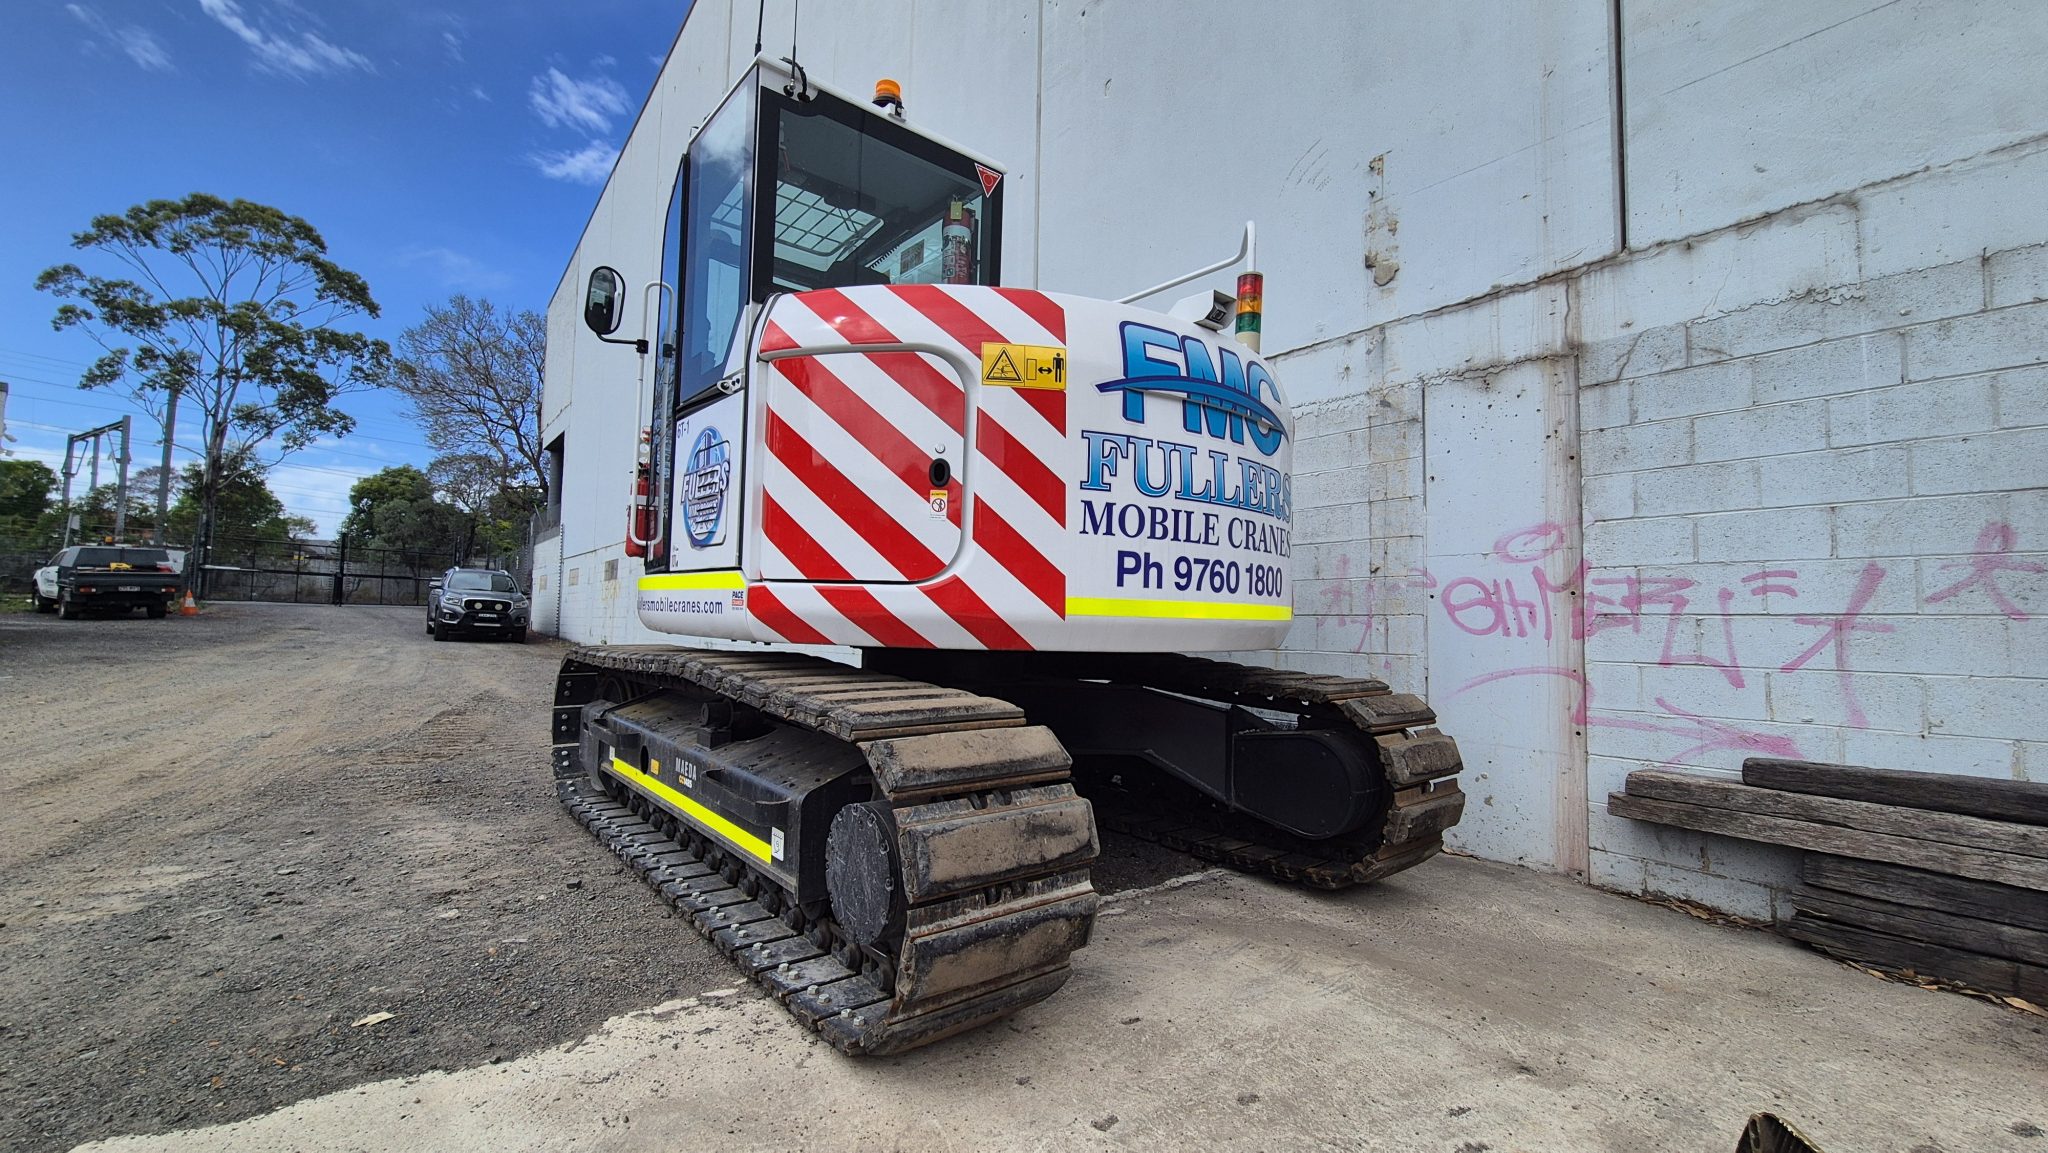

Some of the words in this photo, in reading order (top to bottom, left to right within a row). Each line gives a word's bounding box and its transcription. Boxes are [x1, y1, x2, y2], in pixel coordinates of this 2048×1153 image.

[1118, 320, 1284, 456] FMC
[681, 460, 731, 504] FULLERS
[1080, 430, 1292, 524] FULLERS
[1079, 499, 1220, 546] MOBILE
[1227, 516, 1291, 559] CRANES
[731, 591, 744, 599] PACE
[1116, 549, 1164, 589] Ph
[1173, 555, 1240, 594] 9760
[1245, 562, 1283, 598] 1800
[675, 757, 697, 781] MAEDA
